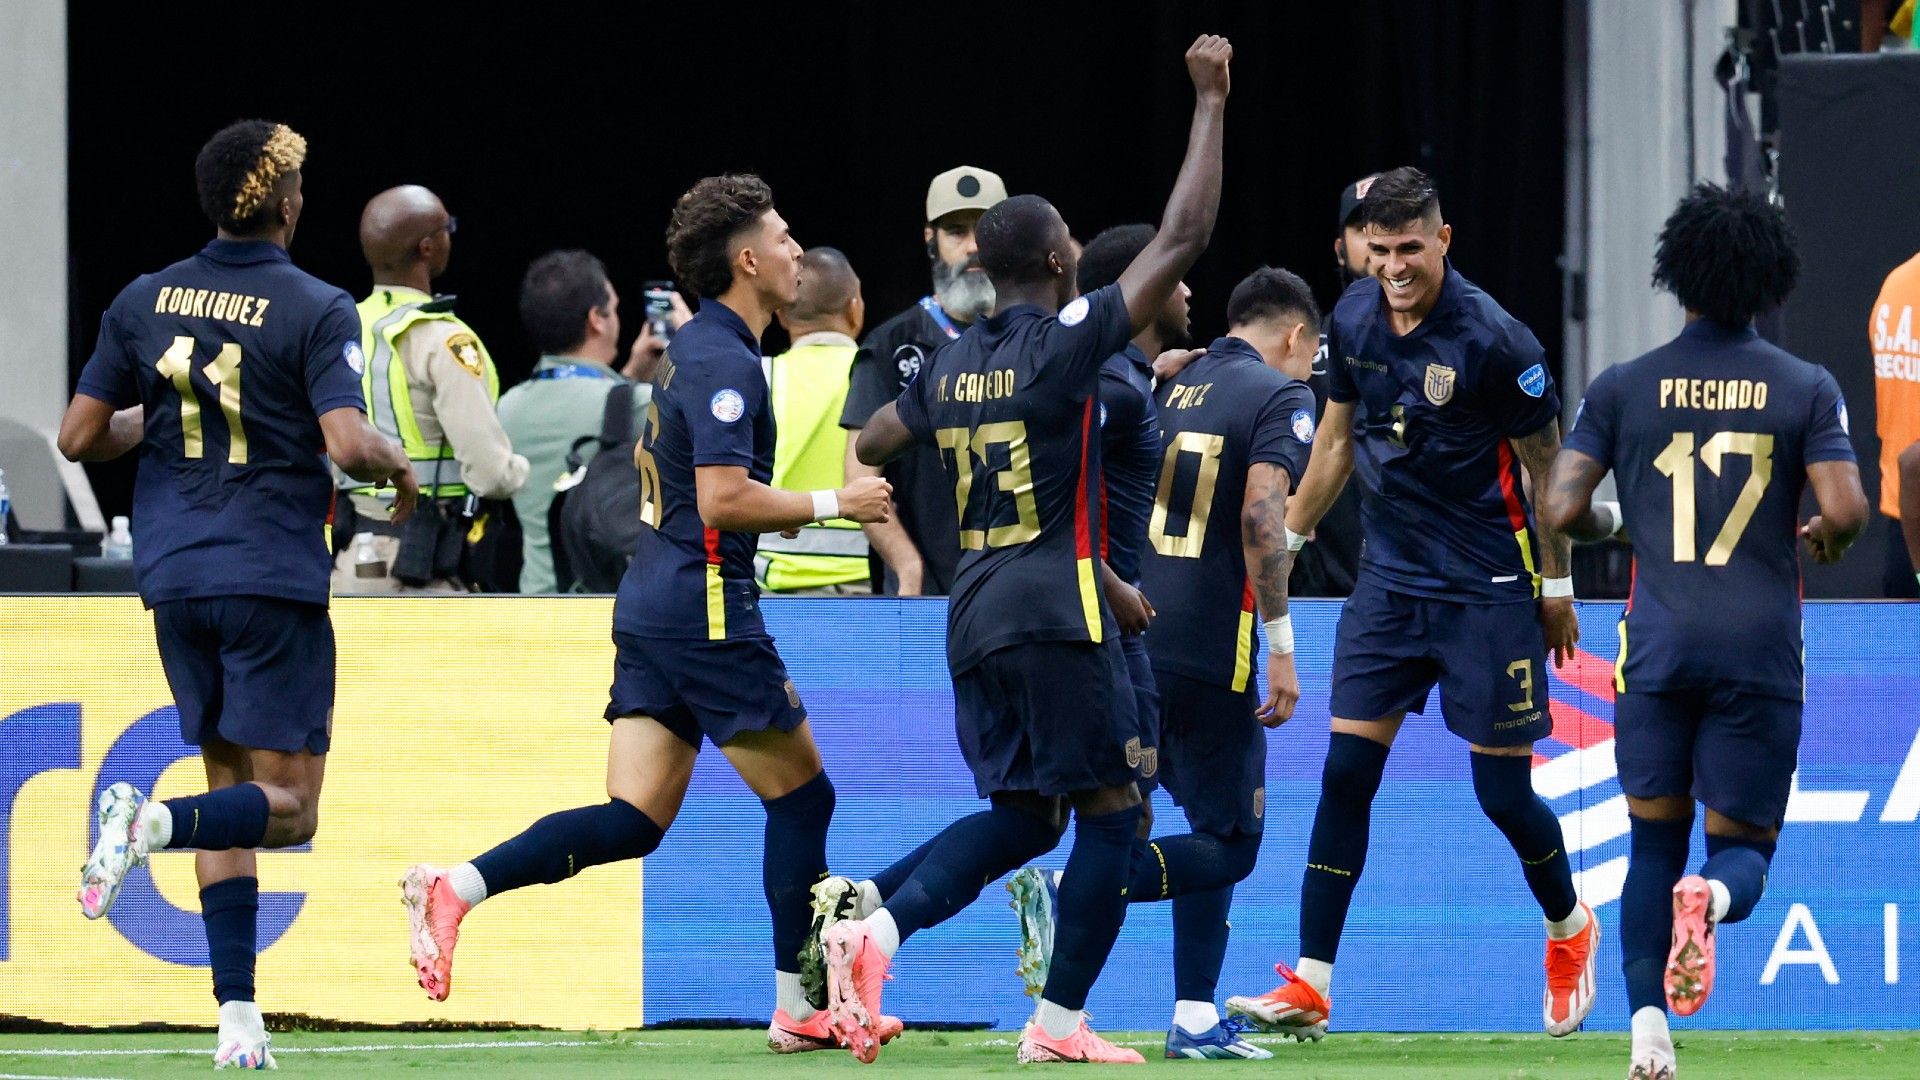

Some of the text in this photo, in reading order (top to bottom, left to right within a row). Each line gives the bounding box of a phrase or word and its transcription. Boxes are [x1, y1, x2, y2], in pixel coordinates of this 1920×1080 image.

[154, 286, 270, 328] RODRIGUEZ
[155, 335, 248, 465] 11
[954, 368, 1015, 403] CAIEDO
[1660, 378, 1769, 411] PRECIADO
[1149, 430, 1225, 559] 0
[1653, 431, 1774, 566] 17
[1506, 658, 1534, 712] 3
[1758, 902, 1899, 985] AI
